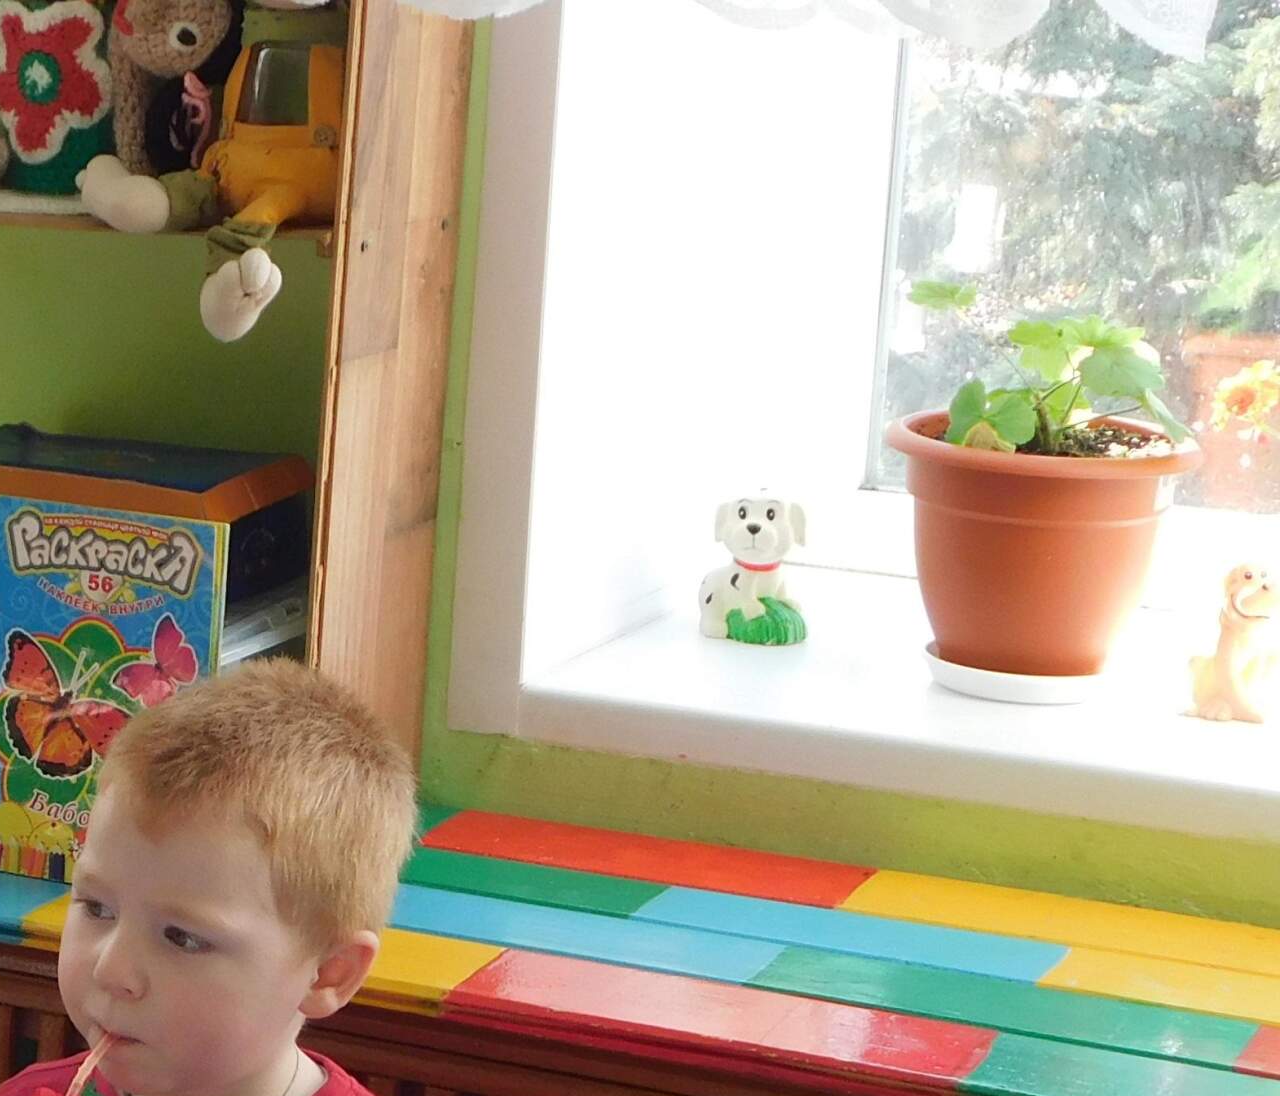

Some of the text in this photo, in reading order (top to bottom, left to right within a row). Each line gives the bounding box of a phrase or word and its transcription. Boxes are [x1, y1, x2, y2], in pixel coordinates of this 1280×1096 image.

[38, 576, 166, 615] НАКЛЕЕК ВНУТРИ
[87, 574, 114, 593] 56
[29, 790, 91, 826] Бабо
